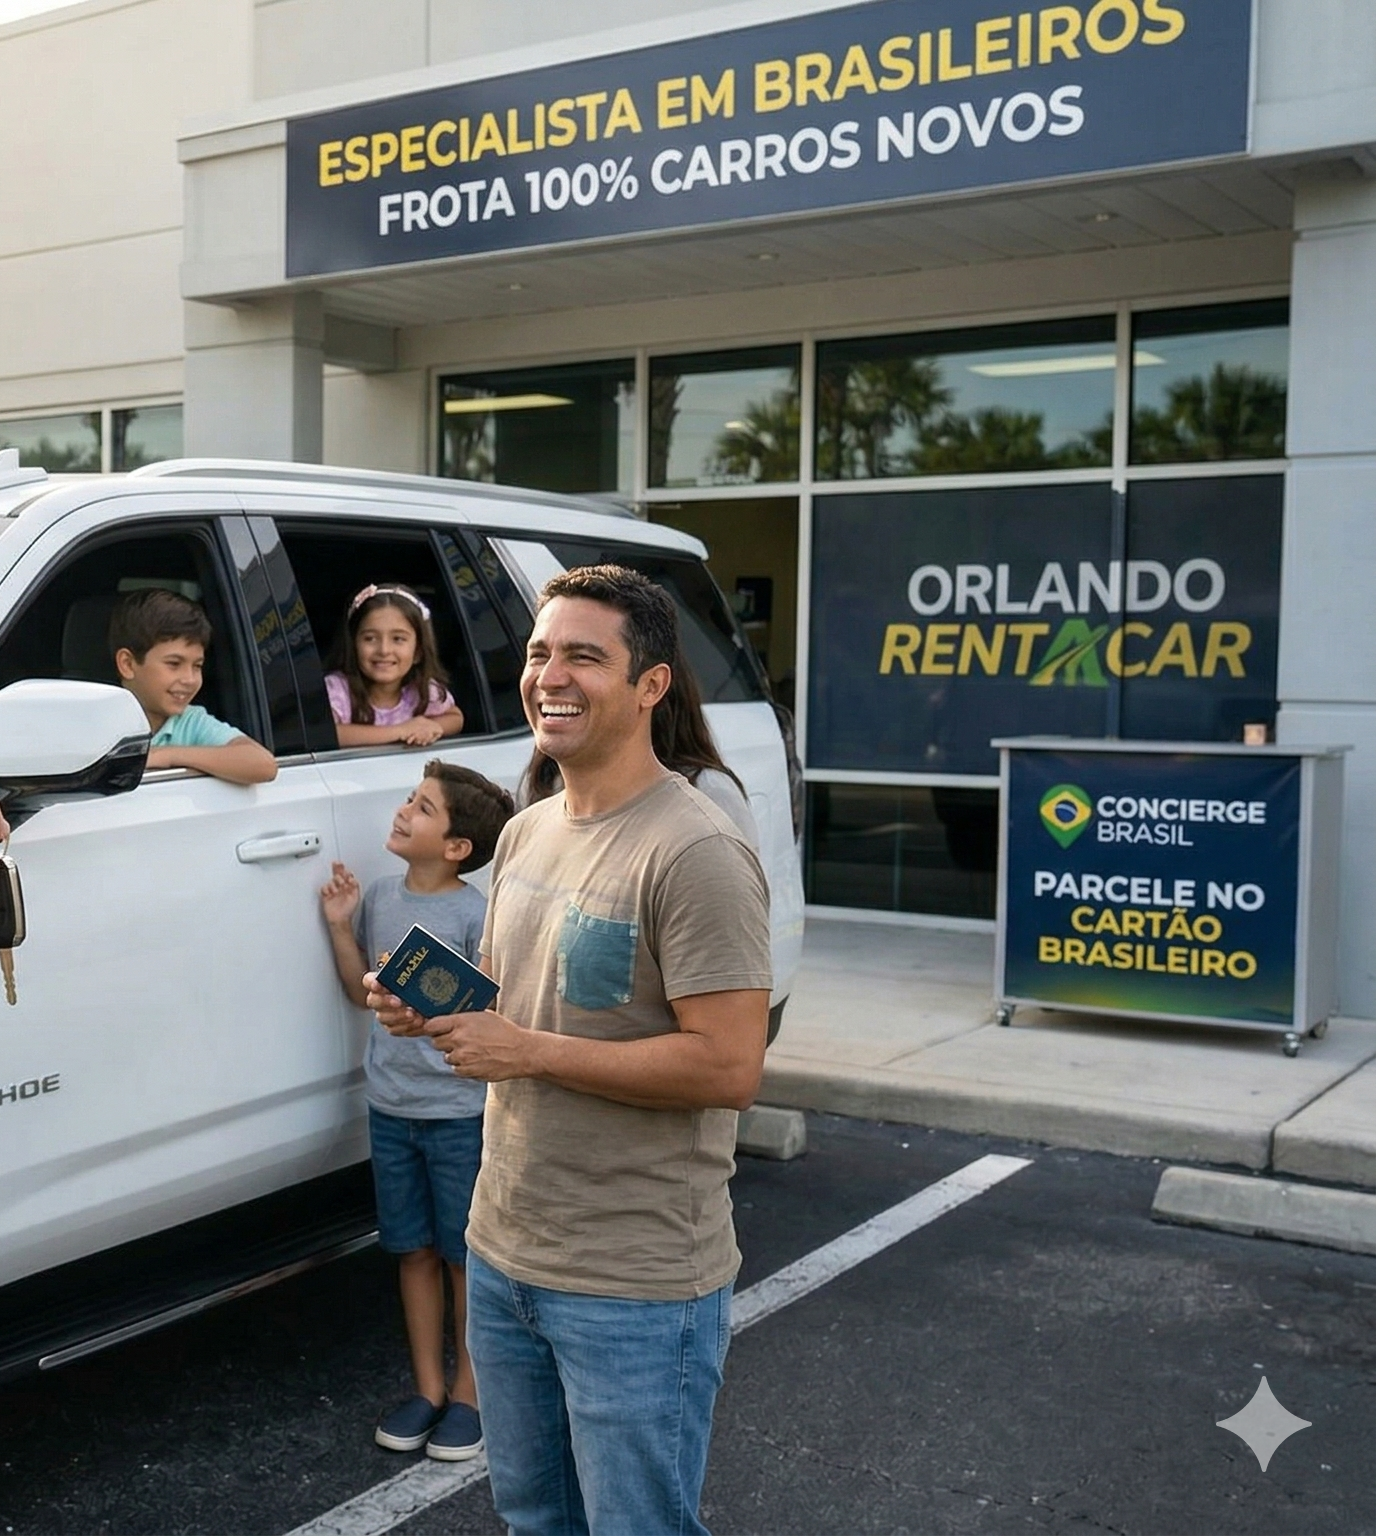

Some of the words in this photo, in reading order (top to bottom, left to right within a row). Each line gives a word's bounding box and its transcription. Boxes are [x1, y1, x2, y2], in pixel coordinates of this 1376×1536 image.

[319, 88, 642, 187] ESPECIALISTA
[657, 68, 735, 130] EM
[754, 0, 1185, 113] BRASILEIROS
[379, 177, 516, 236] FROTA
[525, 156, 638, 213] 100%
[651, 121, 861, 194] CARROS
[877, 85, 1084, 162] NOVOS
[908, 558, 1225, 616] ORLANDO
[1096, 796, 1267, 825] CONCIERGE
[1097, 821, 1194, 846] BRASIL
[1034, 870, 1196, 908] PARCELE
[1207, 882, 1265, 912] NO
[1071, 906, 1223, 942] CARTÃO
[1038, 936, 1257, 979] BRASILEIRO
